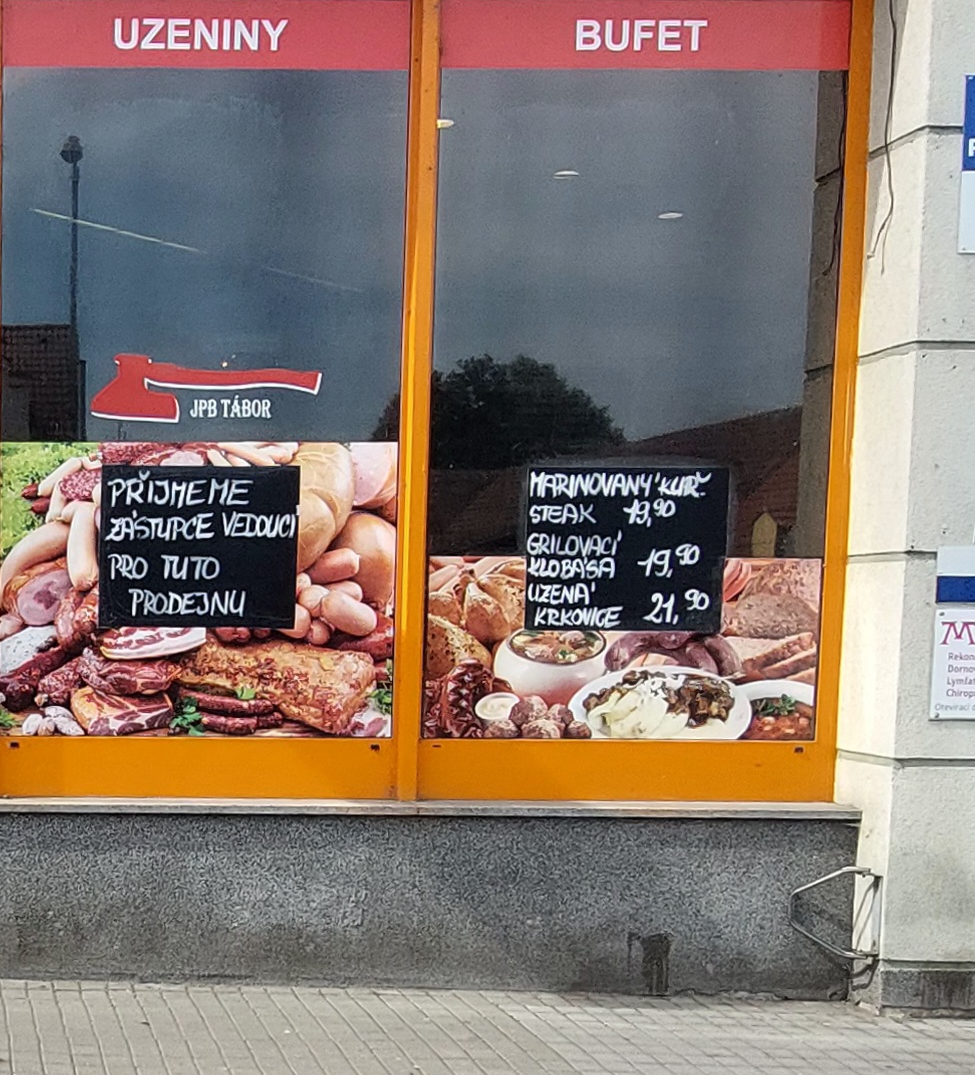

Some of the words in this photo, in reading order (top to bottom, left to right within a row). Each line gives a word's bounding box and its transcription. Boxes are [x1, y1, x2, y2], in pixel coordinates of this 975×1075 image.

[113, 18, 289, 51] UZENINY
[575, 19, 708, 52] BUFET
[189, 398, 217, 418] JPB
[221, 395, 272, 419] TÁBOR
[107, 470, 254, 509] PŘIJMEME
[105, 509, 215, 542] ZÁSTUPCE
[529, 503, 597, 525] STEAK
[527, 529, 622, 557] GRILOVACÍ
[107, 553, 149, 581] PRO
[161, 554, 221, 581] TUTO
[128, 588, 246, 617] PRODEJNU
[527, 582, 596, 605] UZENÁ
[534, 606, 624, 628] KRKOVICE
